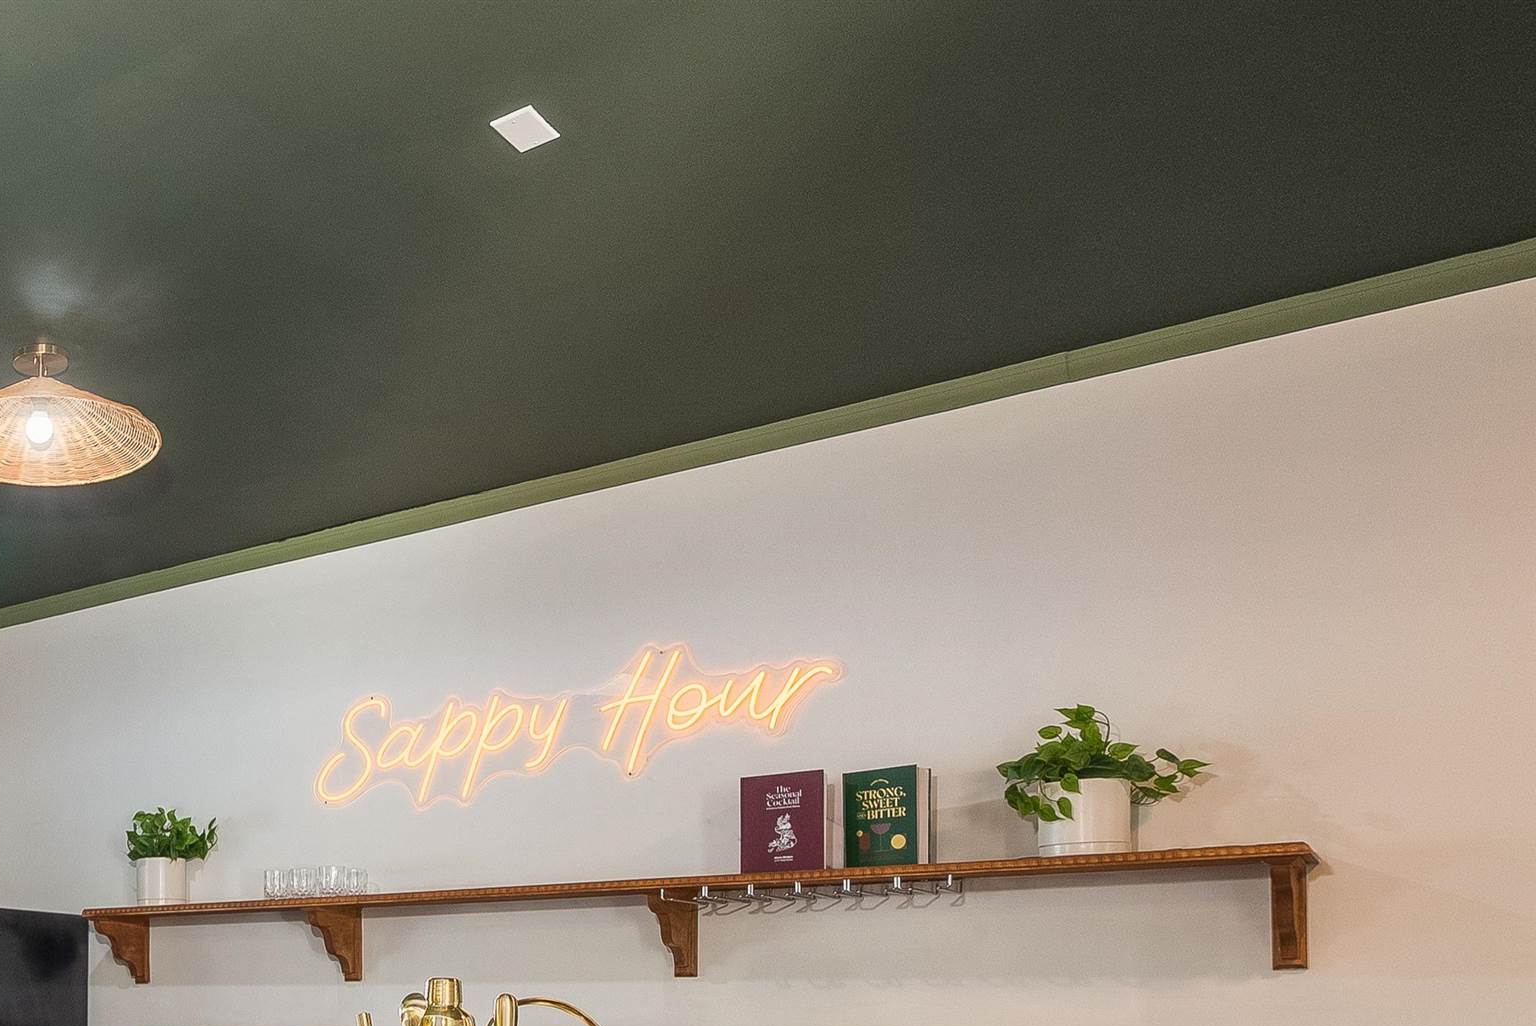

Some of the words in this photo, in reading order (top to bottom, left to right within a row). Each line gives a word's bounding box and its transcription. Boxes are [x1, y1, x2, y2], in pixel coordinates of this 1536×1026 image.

[316, 694, 570, 804] Sappy
[599, 650, 834, 771] Hour
[855, 786, 907, 801] STRONG,
[862, 797, 900, 810] SWEET
[867, 807, 907, 820] BITTER
